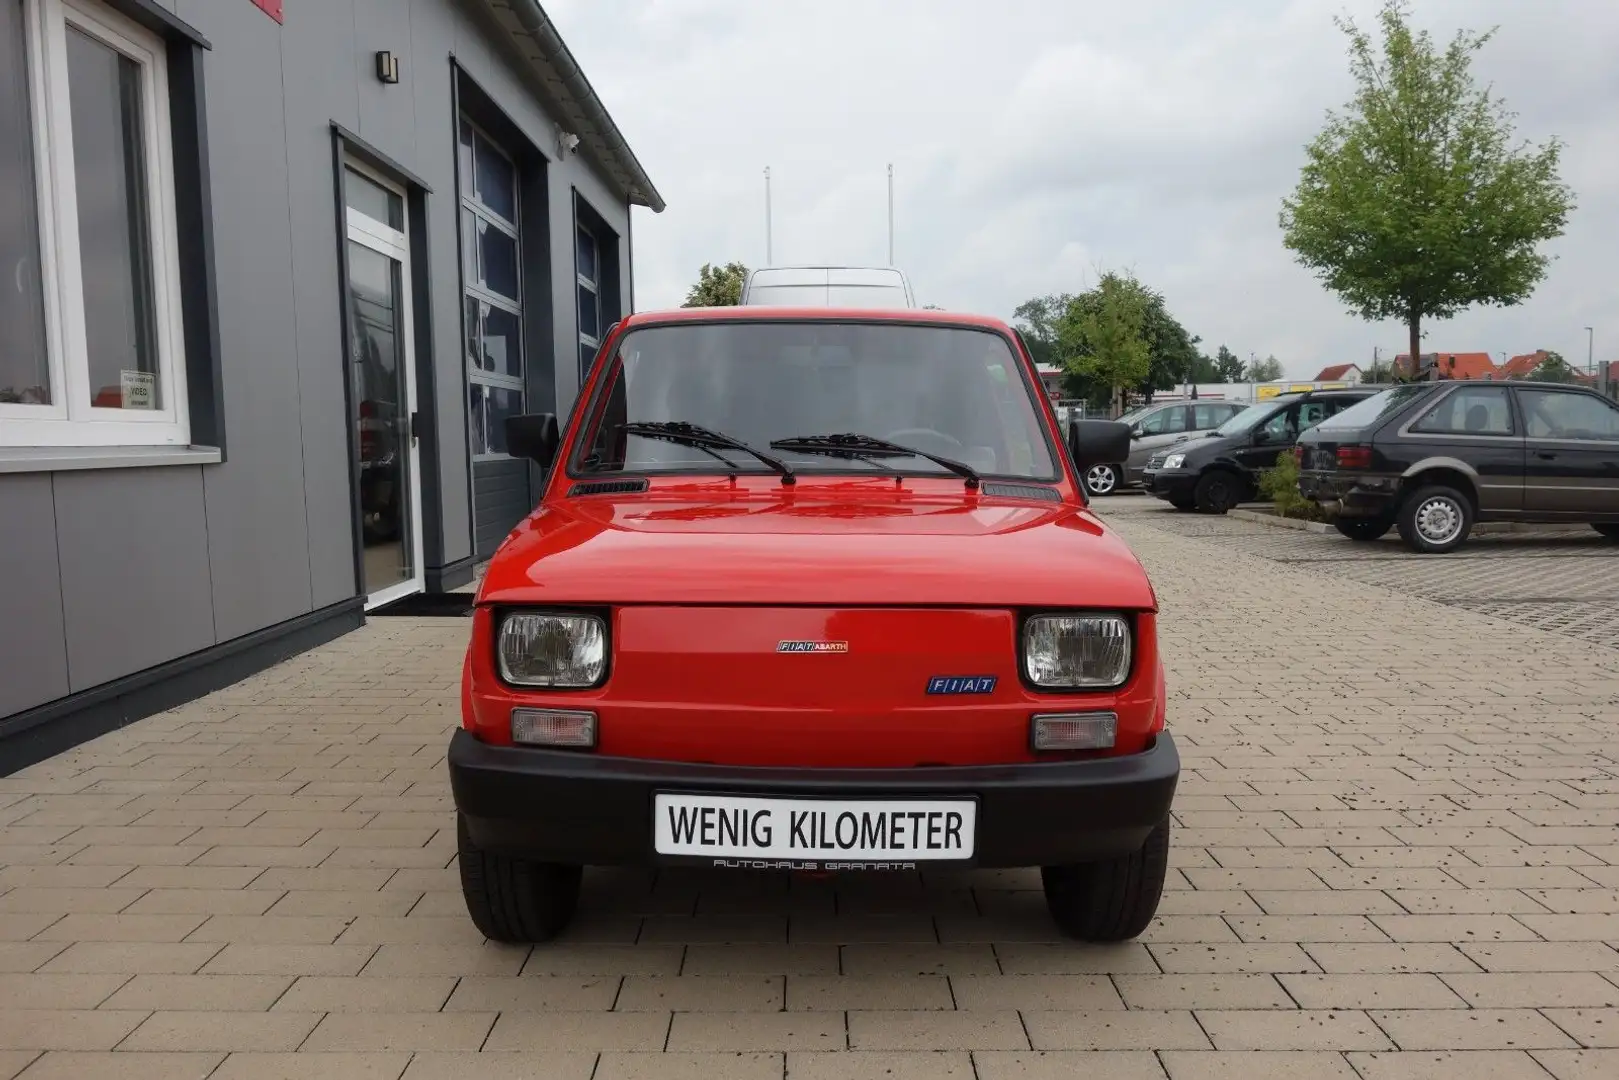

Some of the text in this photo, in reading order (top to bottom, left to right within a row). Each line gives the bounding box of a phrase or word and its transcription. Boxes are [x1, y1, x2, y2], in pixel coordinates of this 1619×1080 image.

[781, 642, 813, 651] FIAT
[933, 678, 992, 692] FIAT
[668, 805, 963, 850] WENIG KILOMETER
[713, 859, 916, 870] AUTOHAUS GRANATA
